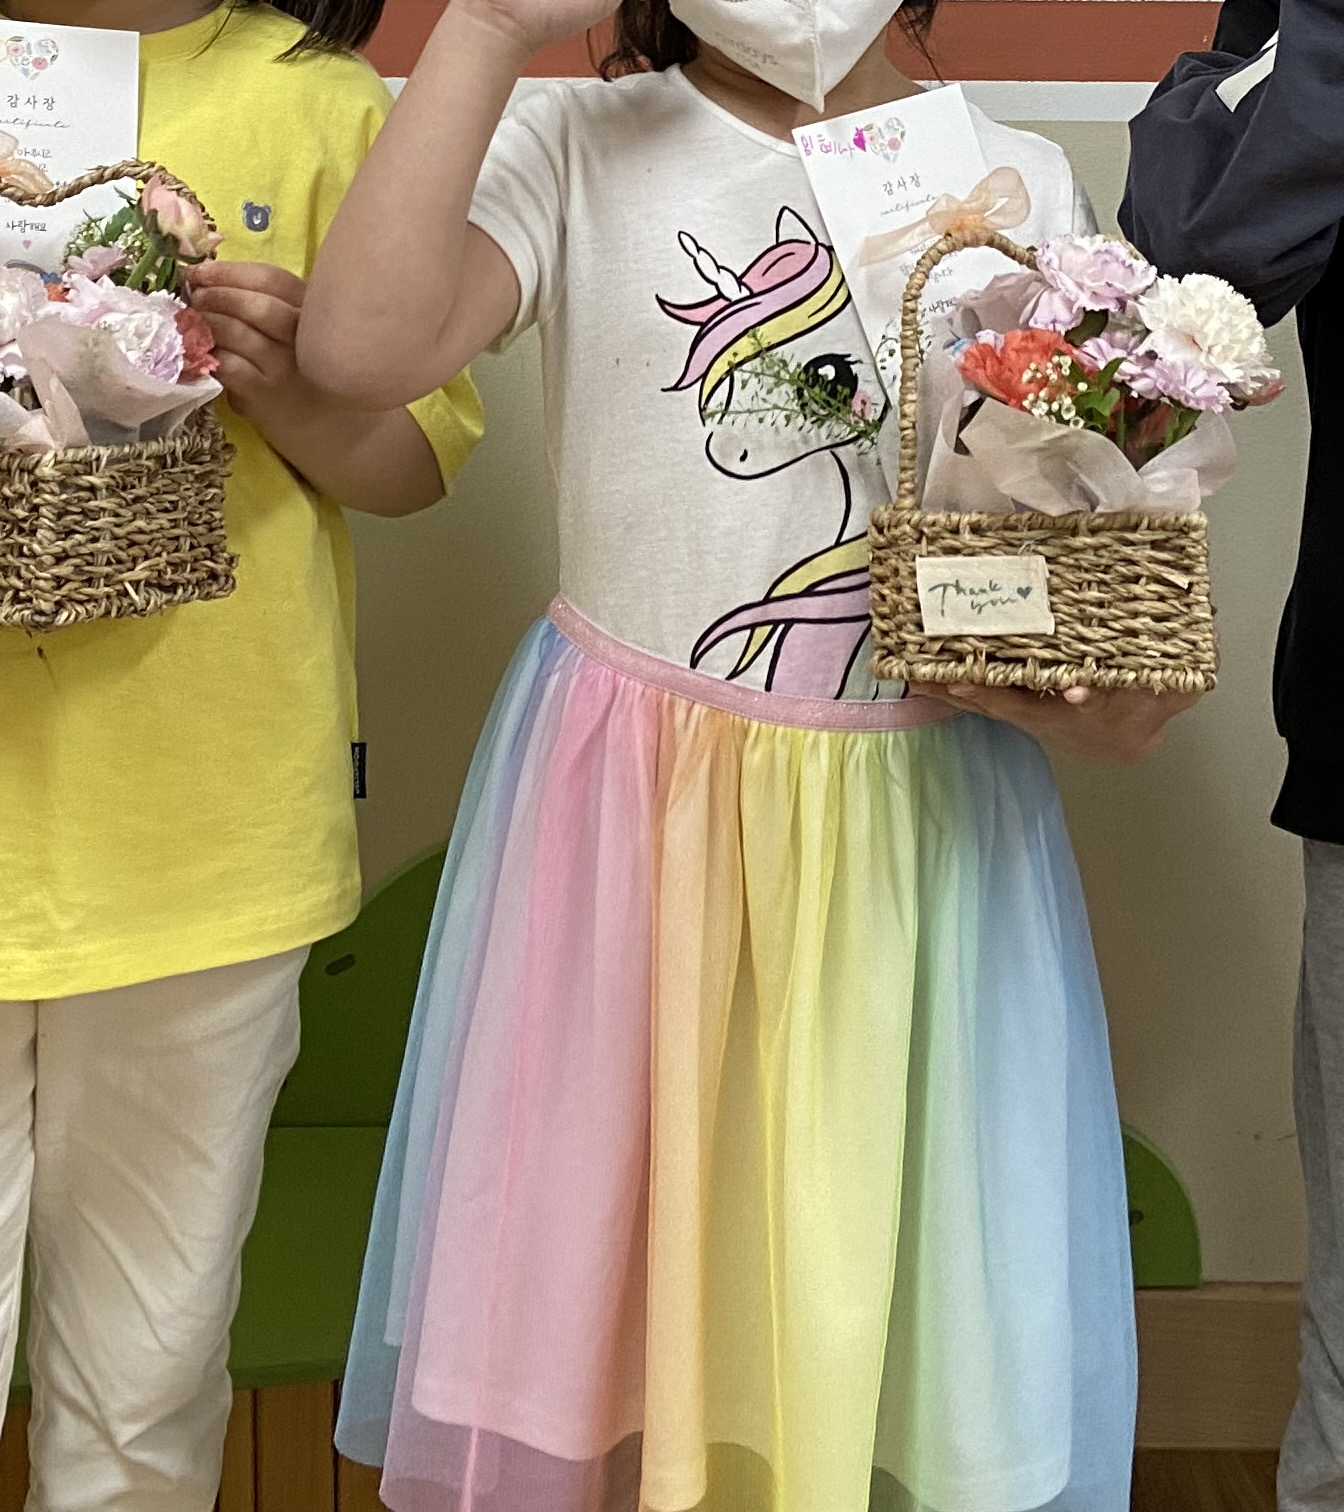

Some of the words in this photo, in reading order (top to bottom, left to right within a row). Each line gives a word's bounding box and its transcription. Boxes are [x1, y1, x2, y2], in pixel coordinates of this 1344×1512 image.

[6, 93, 56, 111] 감사장
[882, 172, 922, 196] 감사장
[927, 579, 1002, 617] Thank
[970, 595, 1018, 615] you
